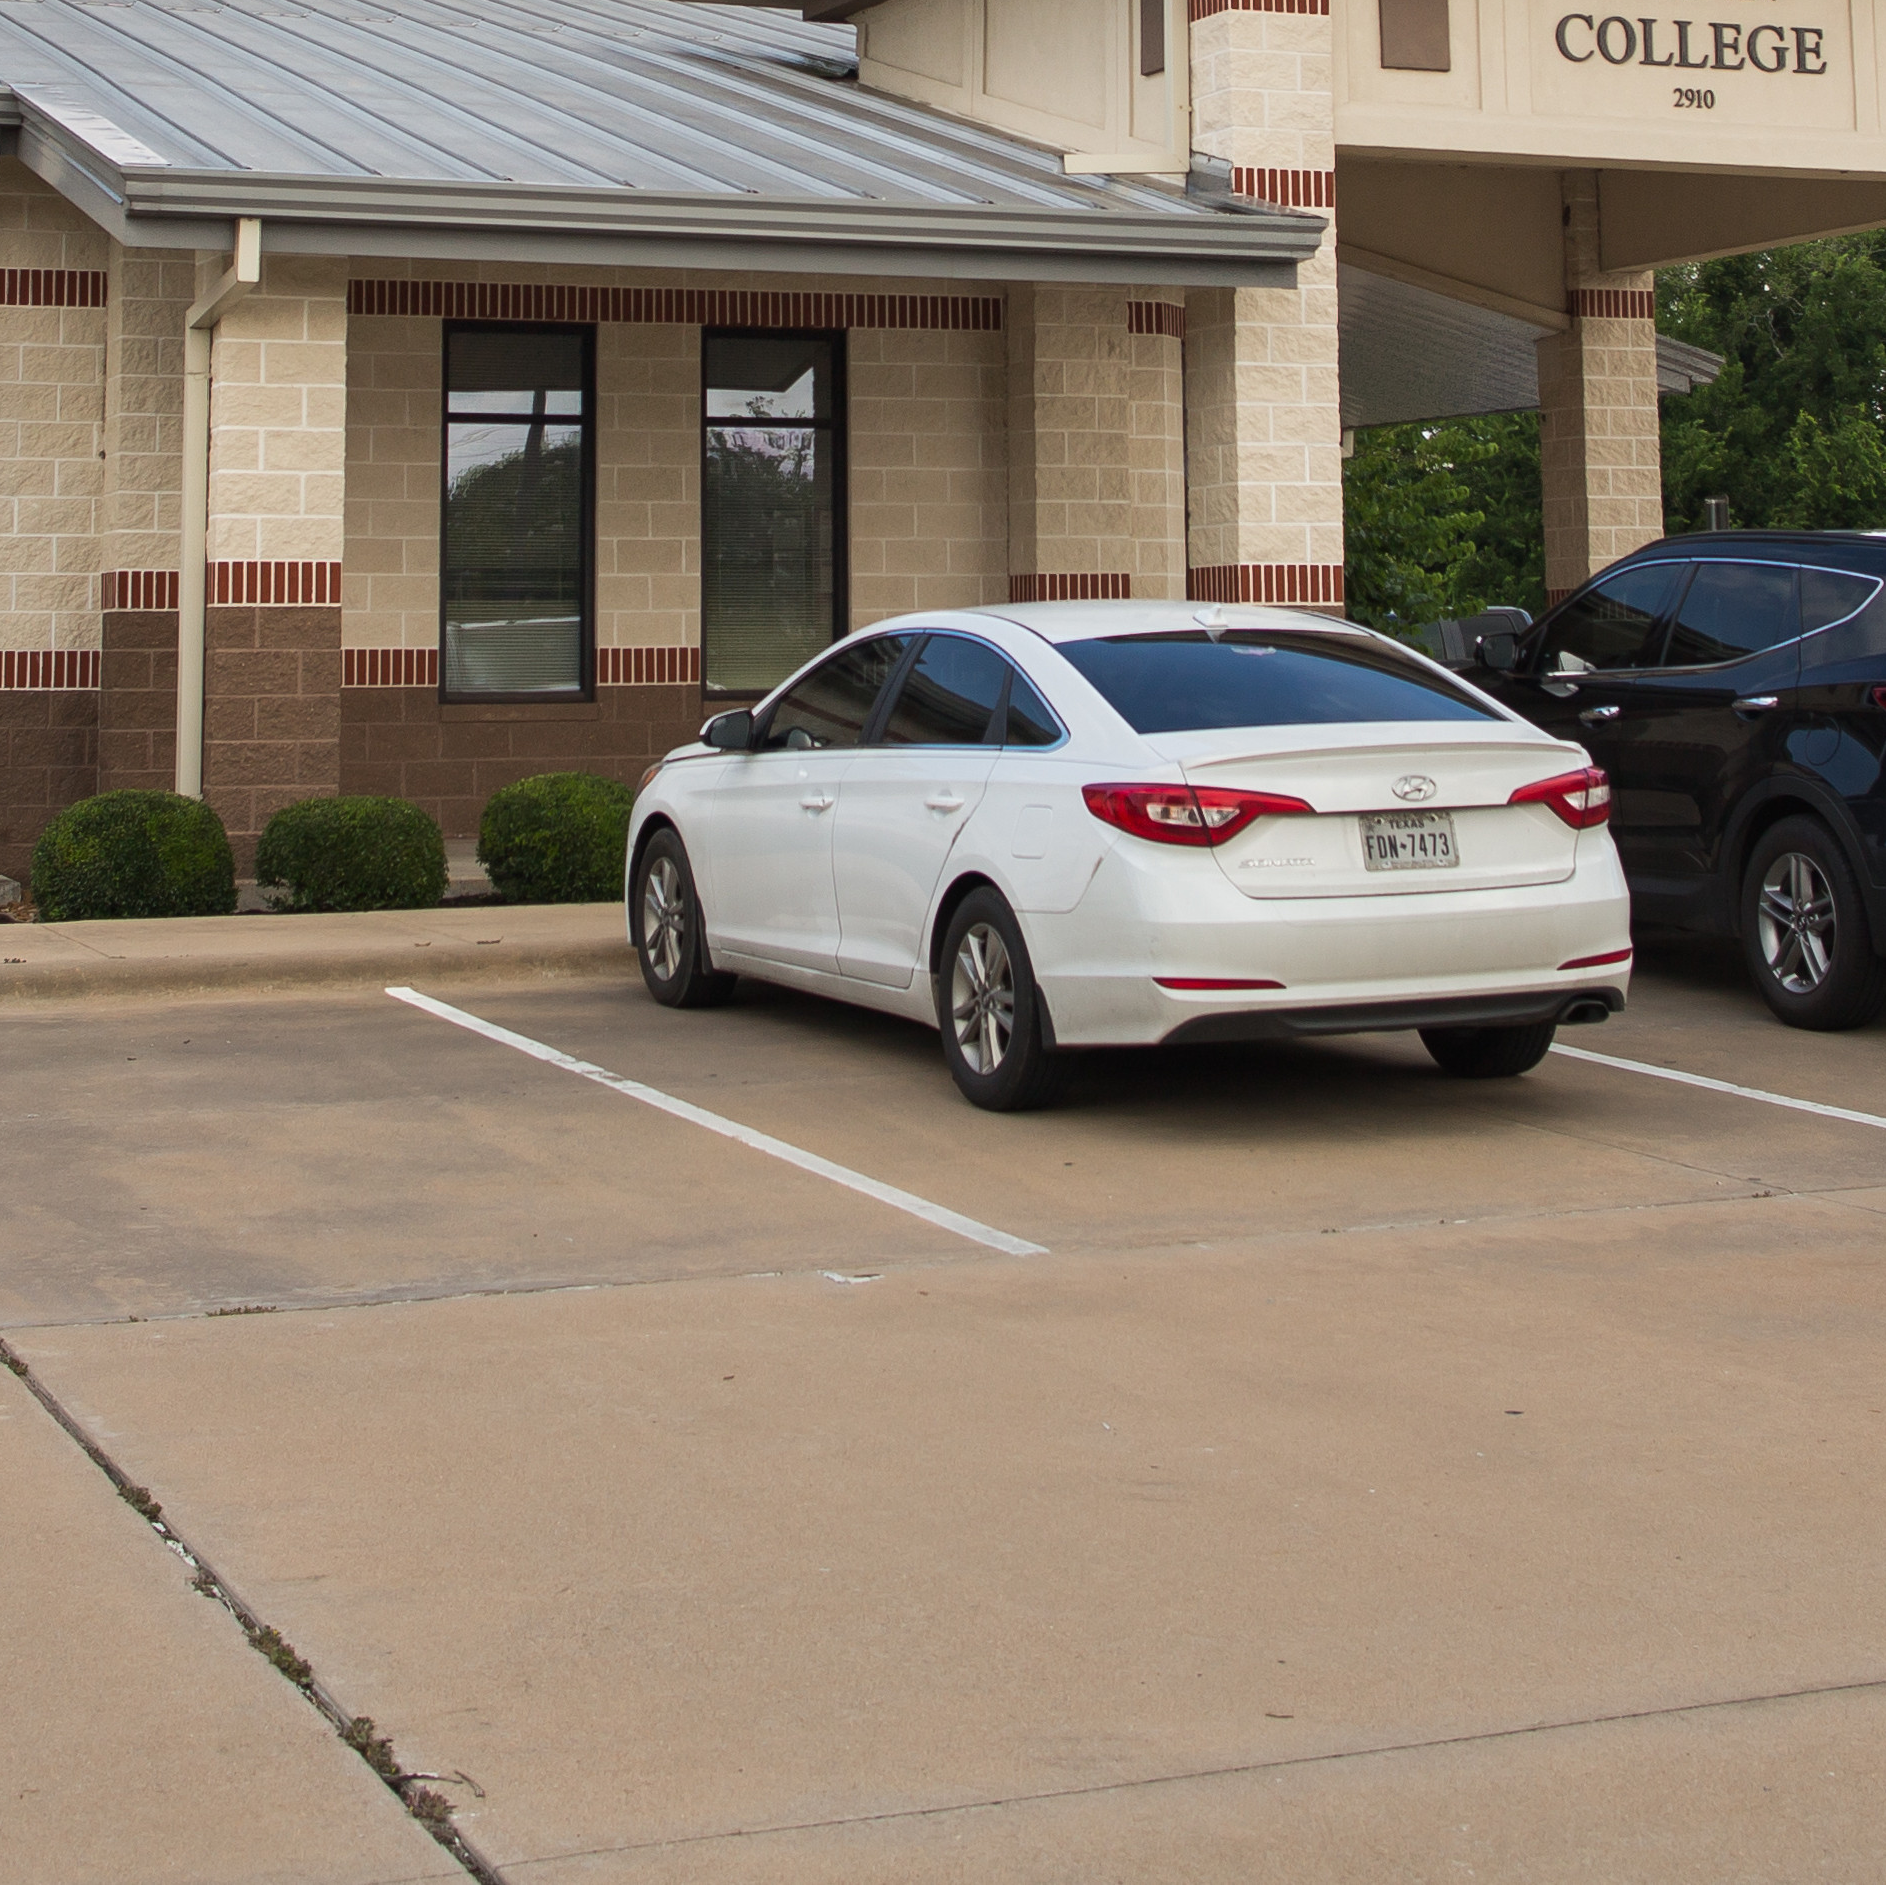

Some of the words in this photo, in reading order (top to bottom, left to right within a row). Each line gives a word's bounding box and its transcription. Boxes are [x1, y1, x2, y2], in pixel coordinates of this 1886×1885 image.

[1554, 13, 1828, 75] COLLEGE
[1673, 87, 1715, 110] 2910
[1389, 819, 1425, 829] TEXAS
